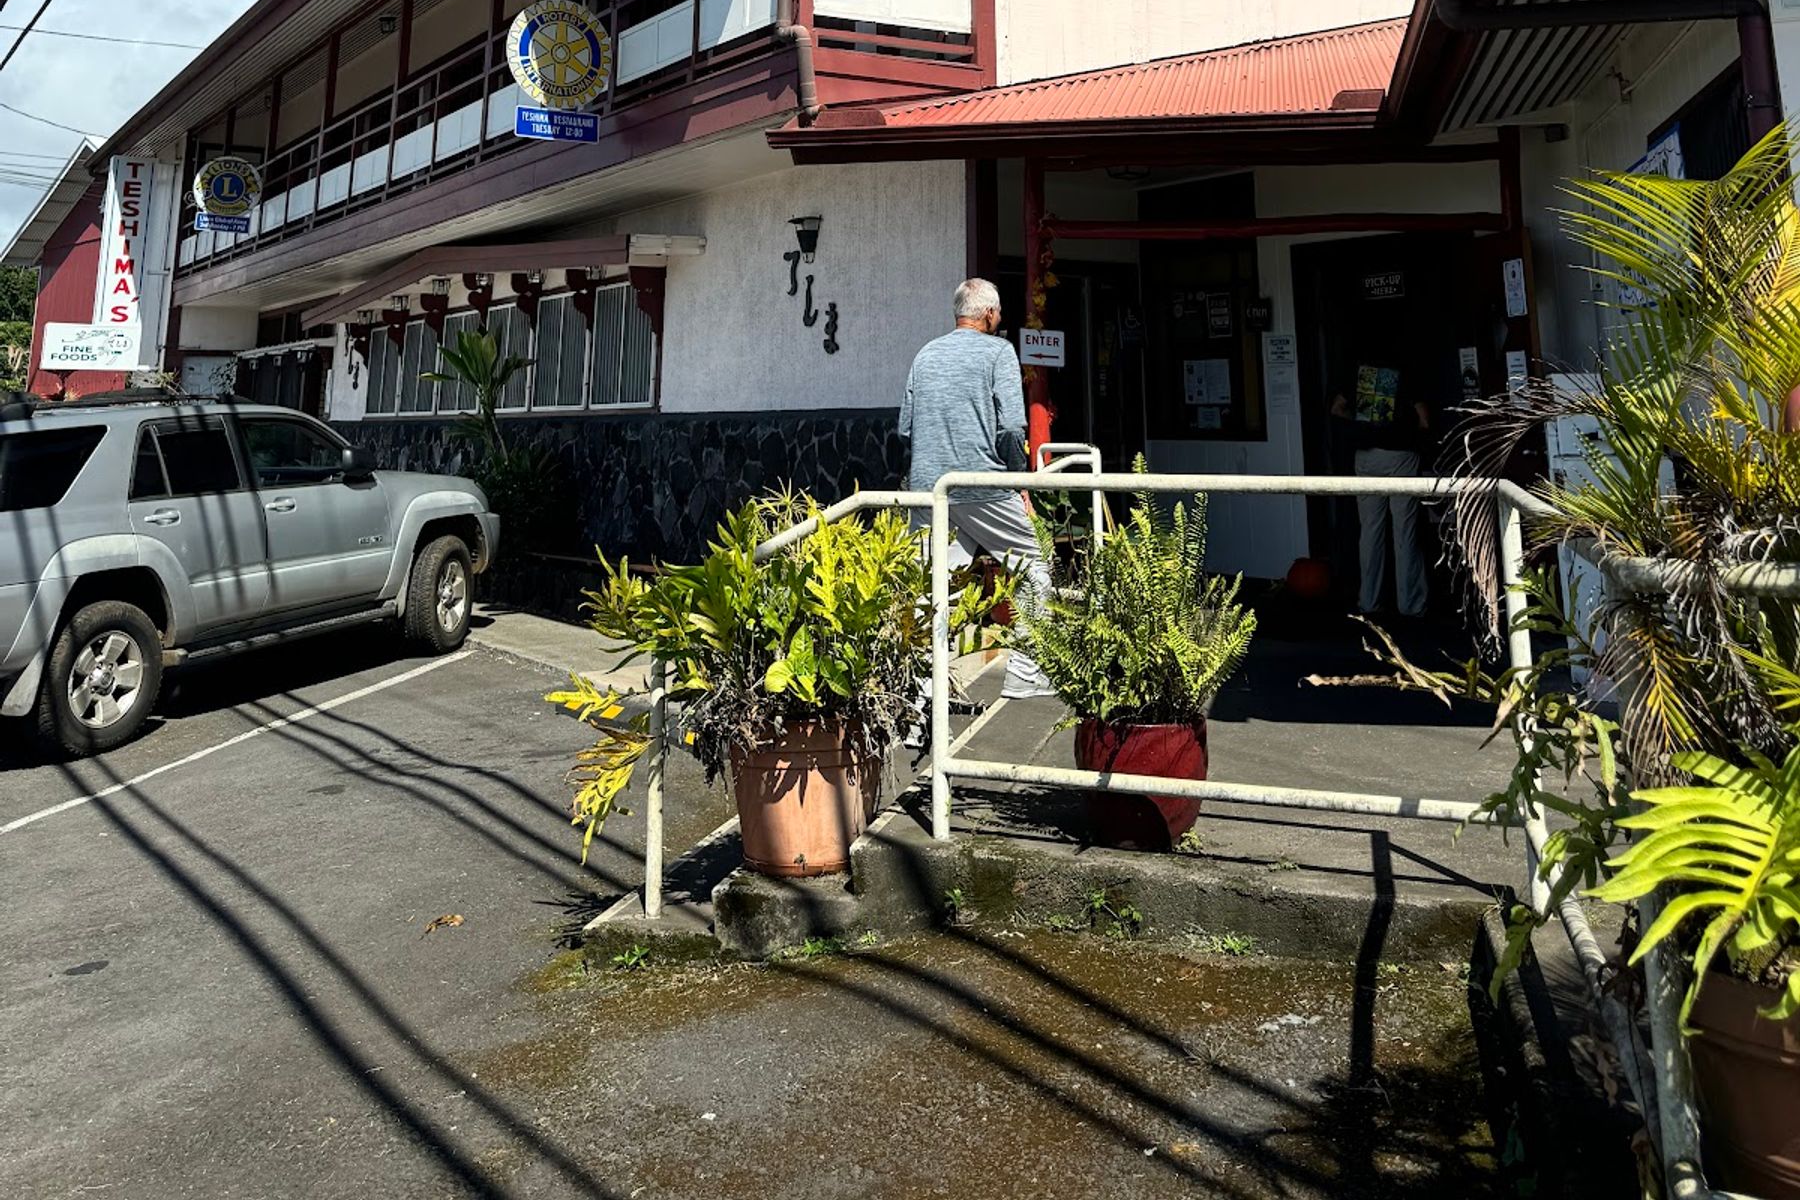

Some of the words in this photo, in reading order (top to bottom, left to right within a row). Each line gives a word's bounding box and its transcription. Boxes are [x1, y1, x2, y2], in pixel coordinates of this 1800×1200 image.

[542, 12, 583, 28] ROTARY
[522, 59, 597, 96] INTERNATIONAL
[211, 162, 250, 176] LIONS
[221, 177, 238, 197] L
[1025, 334, 1060, 347] ENTER
[62, 345, 93, 354] FINE
[50, 353, 98, 362] FOODS
